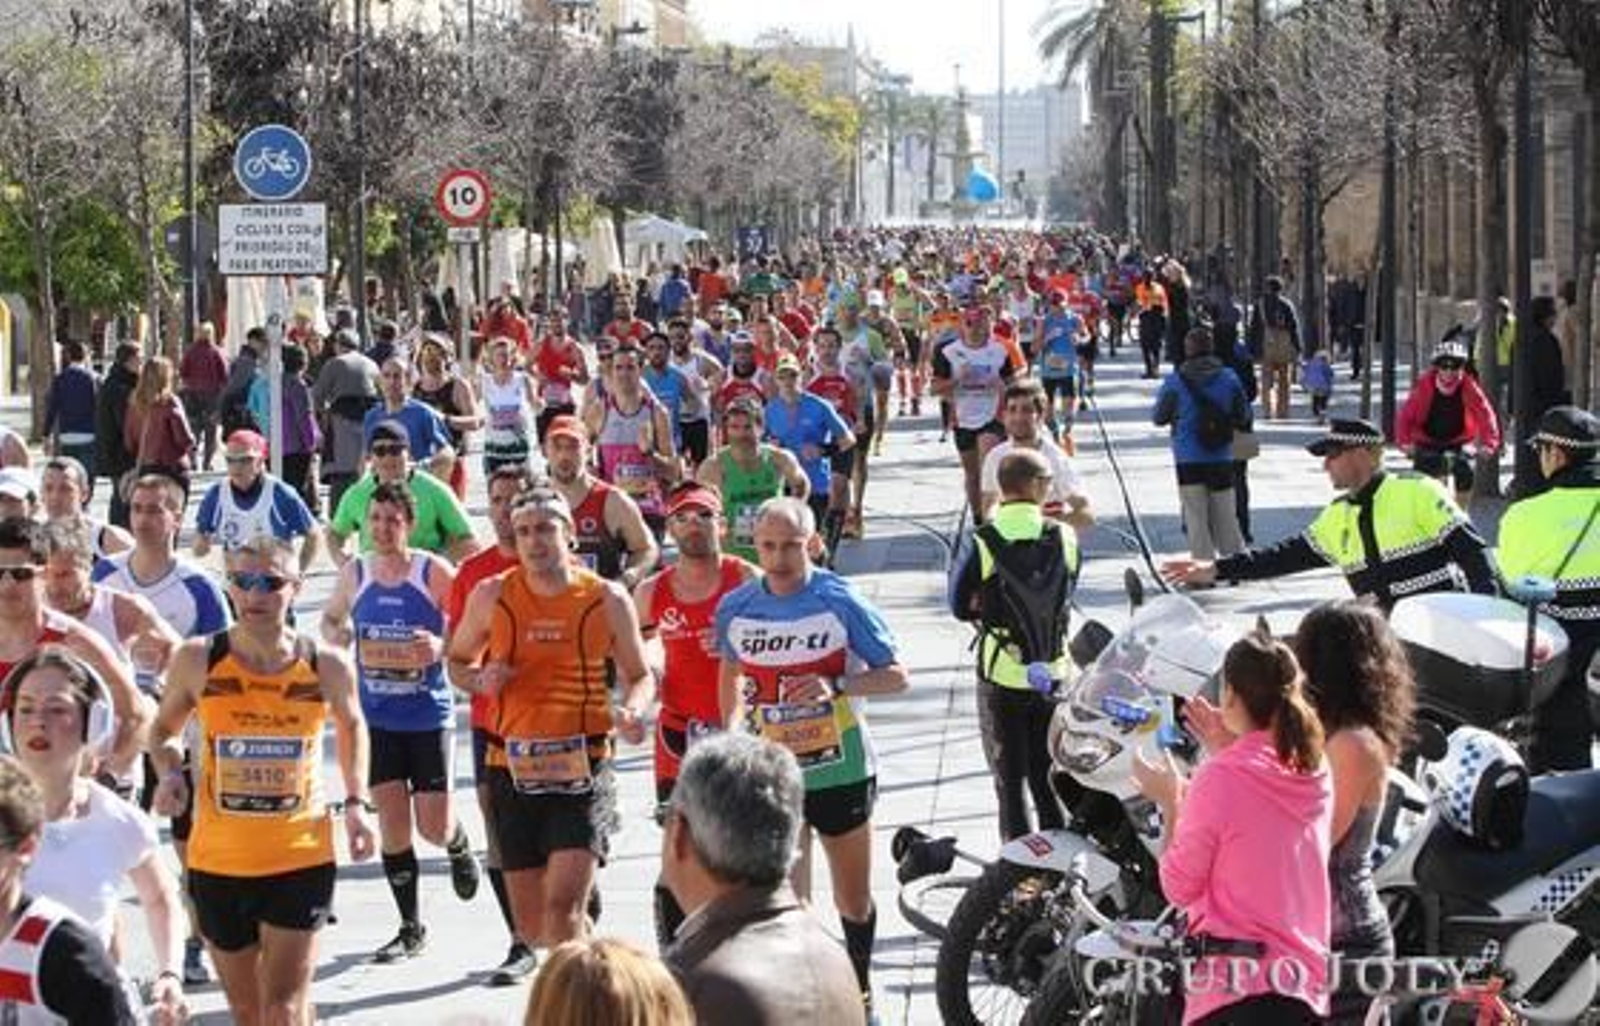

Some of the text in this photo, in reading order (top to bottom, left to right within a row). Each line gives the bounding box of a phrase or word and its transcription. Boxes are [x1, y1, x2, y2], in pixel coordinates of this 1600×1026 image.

[450, 187, 477, 205] 10
[241, 206, 303, 217] ITINERARIO
[235, 224, 310, 236] CICLISTA CON
[235, 241, 292, 253] PRIORIDAD
[229, 259, 315, 271] PASO PEATONAL
